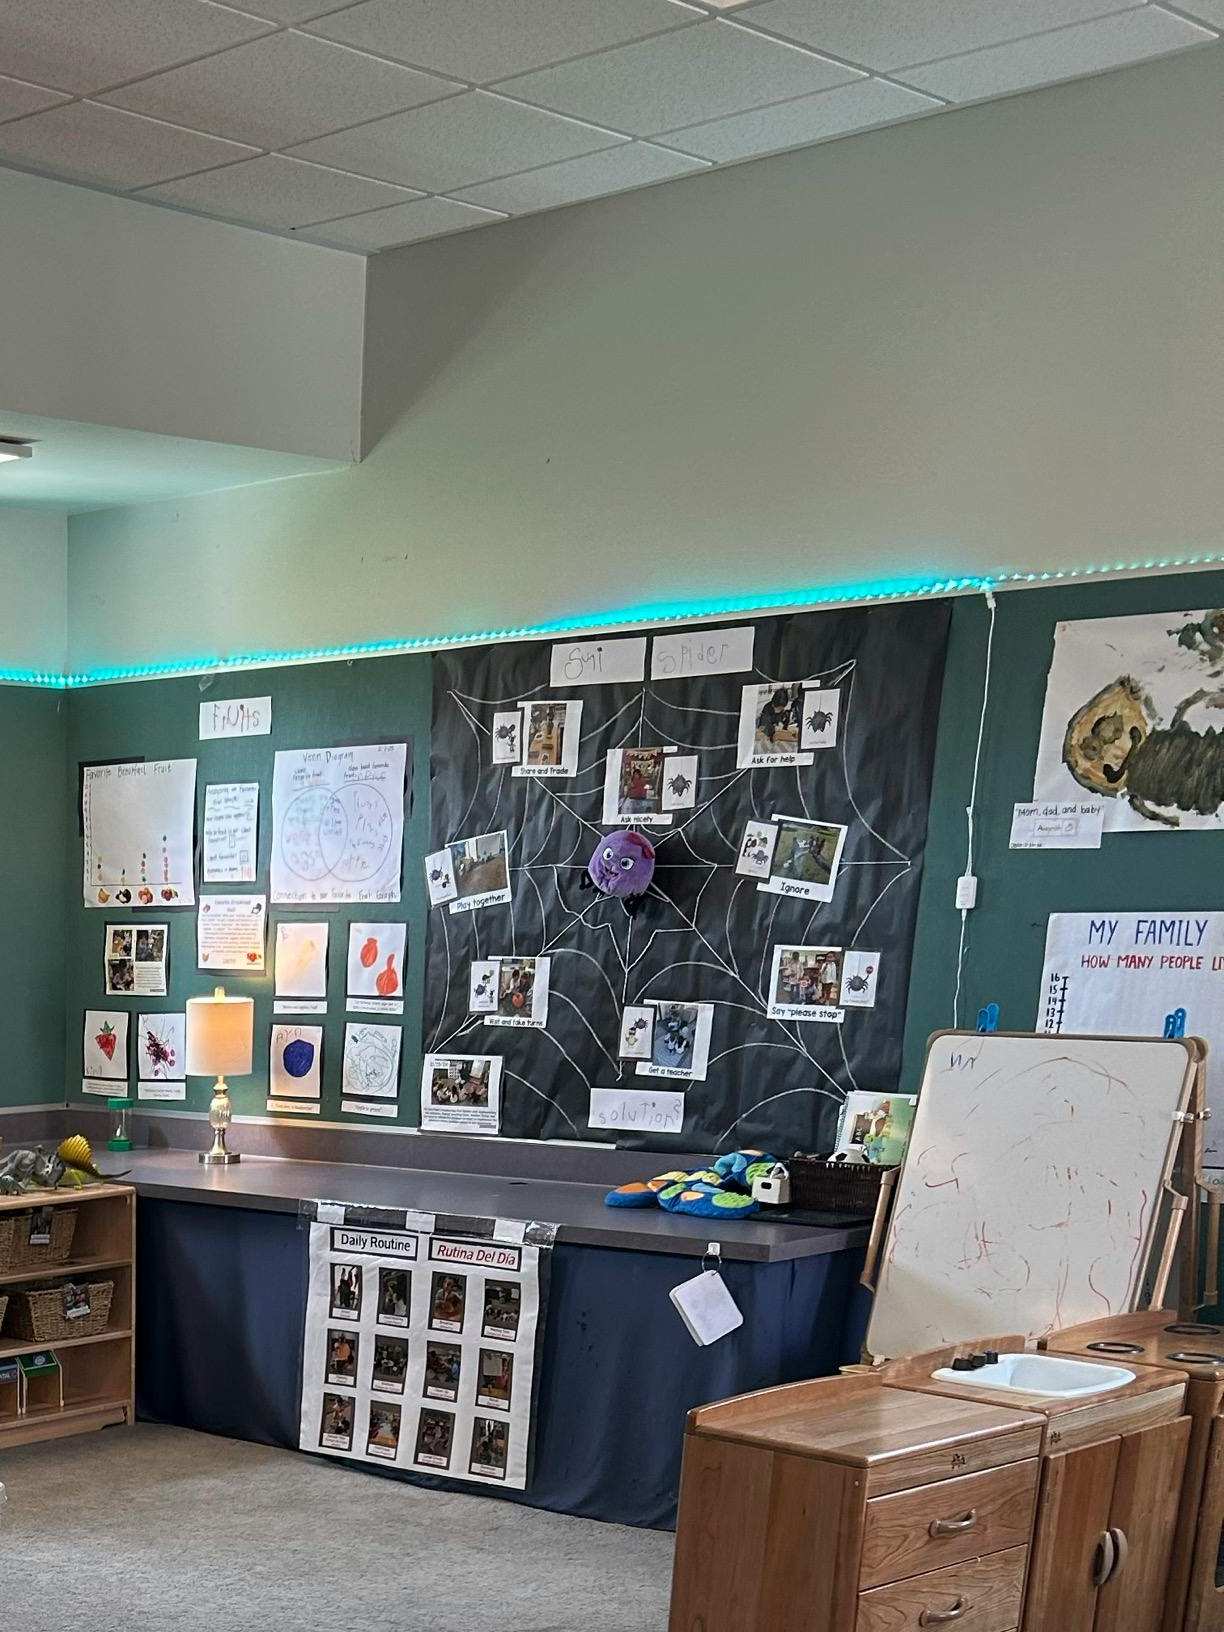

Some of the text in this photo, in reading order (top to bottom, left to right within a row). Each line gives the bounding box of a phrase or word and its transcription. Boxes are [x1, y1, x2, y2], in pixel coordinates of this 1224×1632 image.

[751, 755, 796, 764] Ask for help
[537, 767, 548, 775] and
[550, 767, 569, 775] Trade
[1062, 805, 1077, 815] and
[620, 815, 632, 824] Ask
[780, 882, 810, 895] Ignore
[456, 893, 506, 911] Play together
[1088, 919, 1208, 946] MY FAMILY
[1081, 954, 1110, 969] HOW
[1117, 955, 1154, 970] MANY
[1160, 956, 1204, 970] PEOPLE
[1050, 973, 1060, 982] 16
[1049, 985, 1058, 995] 15
[1047, 996, 1057, 1006] 14
[771, 1006, 786, 1017] Say
[1046, 1008, 1056, 1017] 13
[1044, 1019, 1054, 1029] 12
[667, 1069, 693, 1077] teacher
[340, 1233, 411, 1252] Daily Routine
[437, 1245, 516, 1266] Rutina Del Día
